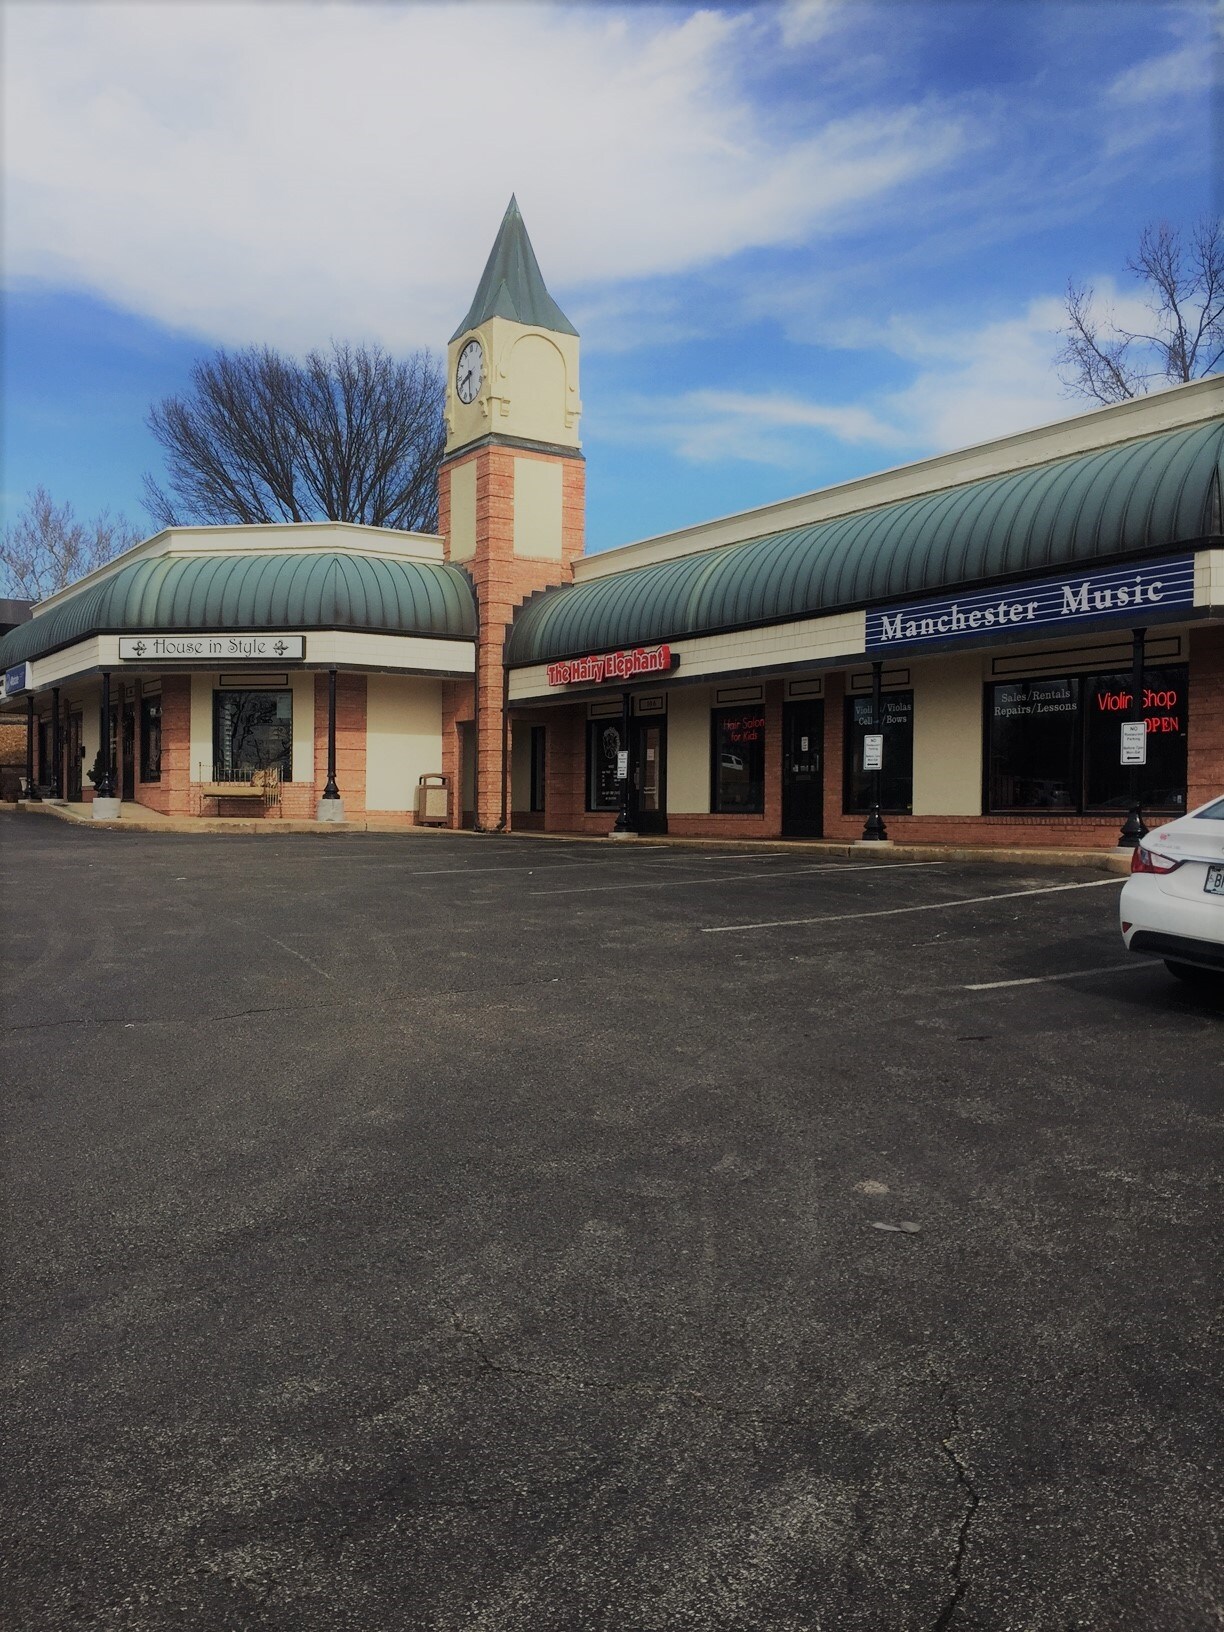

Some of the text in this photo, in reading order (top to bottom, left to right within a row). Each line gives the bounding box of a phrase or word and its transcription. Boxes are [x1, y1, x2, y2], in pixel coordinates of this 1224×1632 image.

[880, 576, 1164, 641] Manchester Music
[153, 639, 266, 657] House in Style
[547, 646, 664, 686] The Hairy Elephant
[1001, 689, 1071, 703] Sales/Rentals
[1097, 691, 1133, 711] Violin
[994, 702, 1077, 717] Repairs/Lessons
[723, 717, 765, 731] Hair Salon
[1144, 716, 1179, 733] OPEN
[731, 731, 758, 742] for Kids
